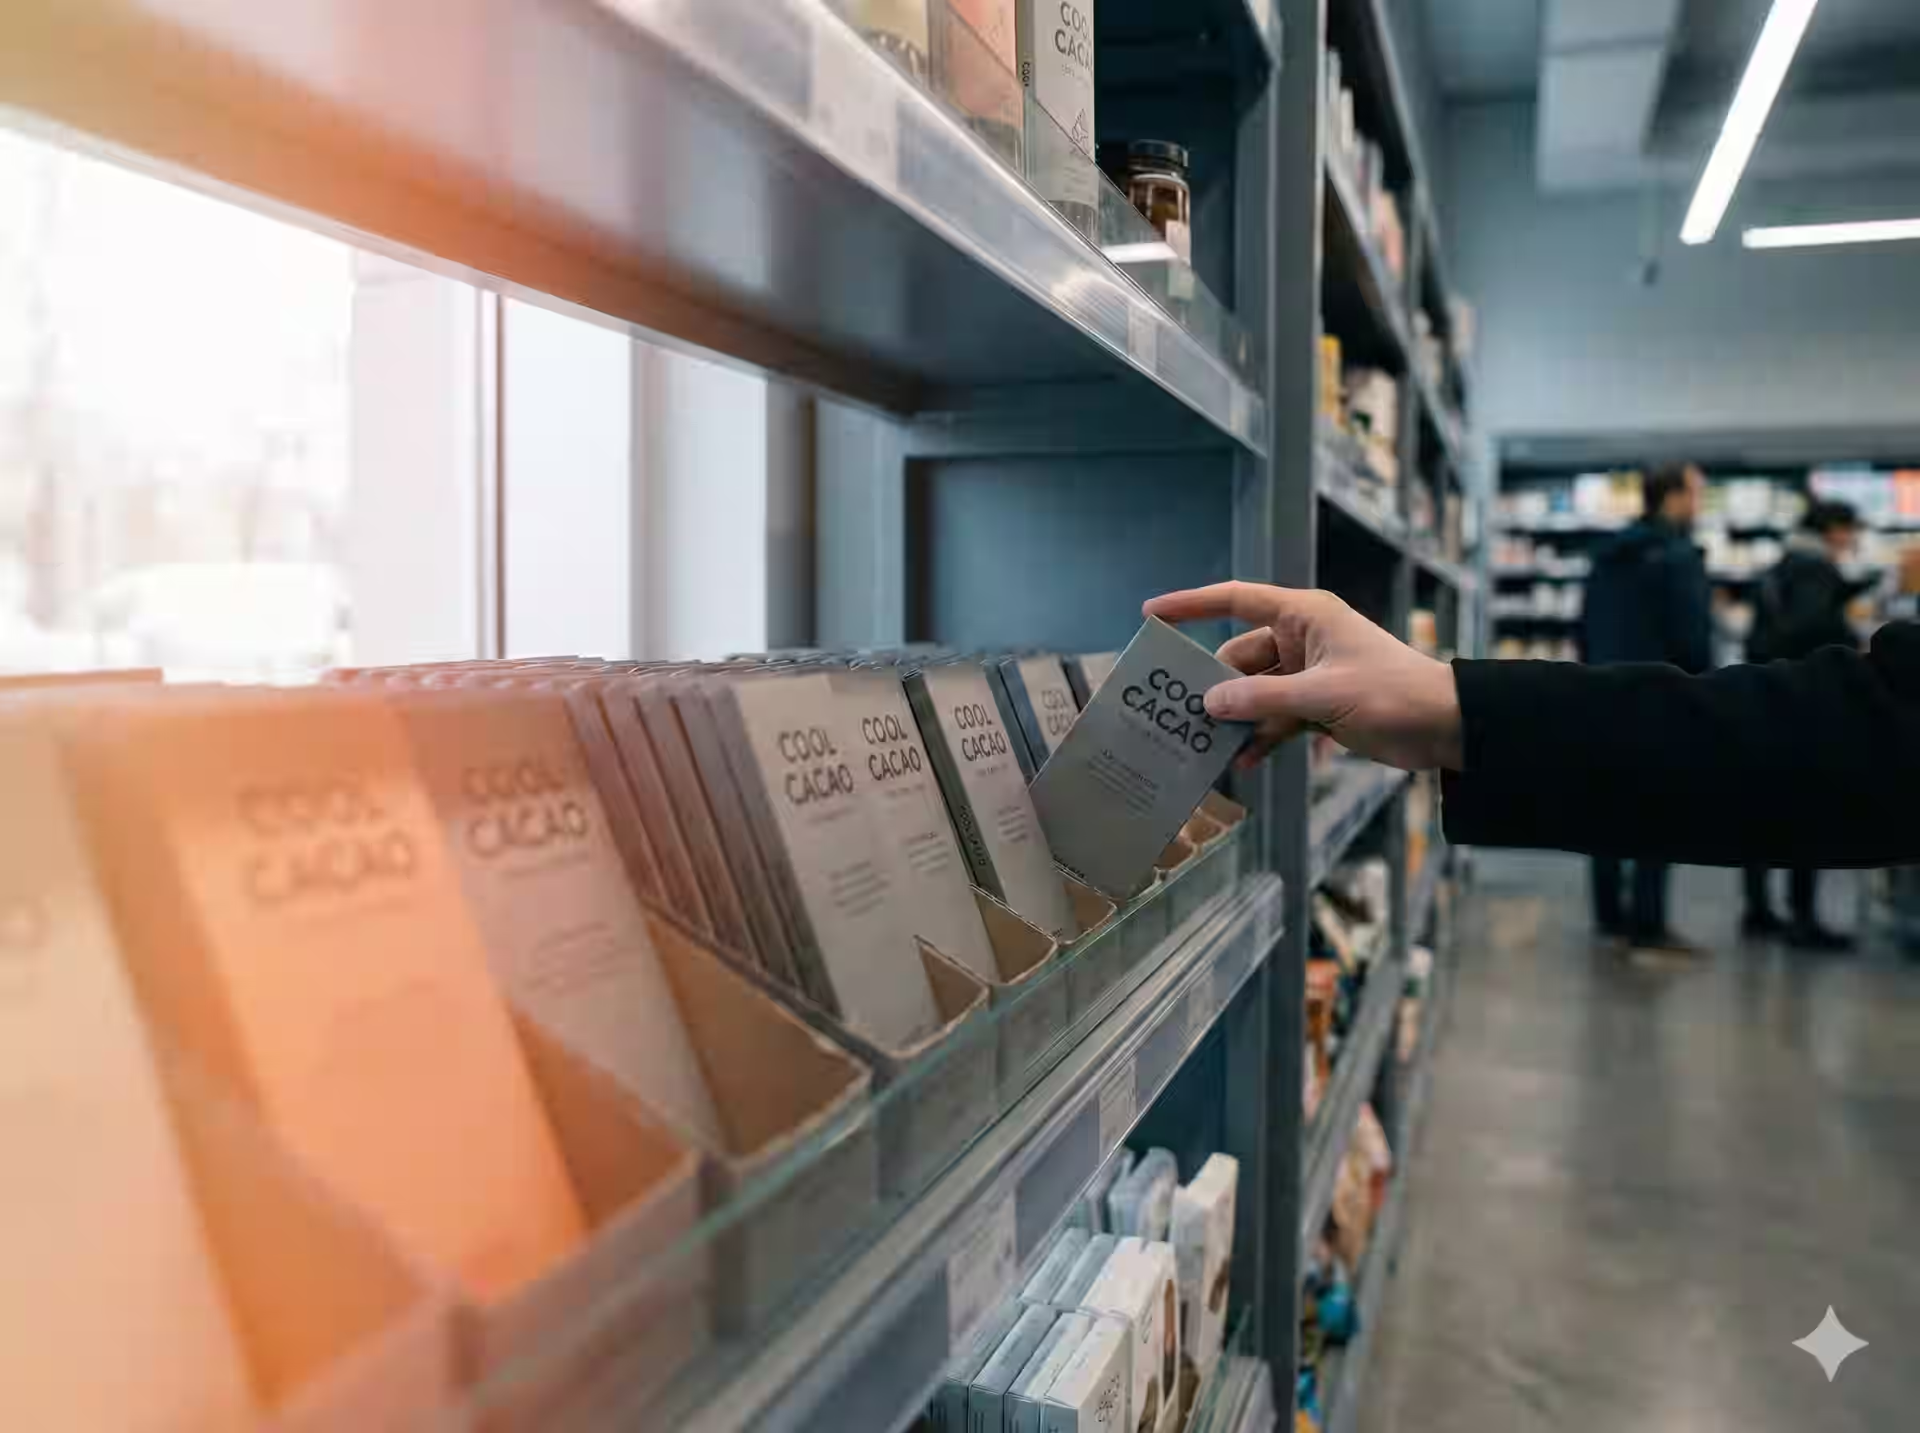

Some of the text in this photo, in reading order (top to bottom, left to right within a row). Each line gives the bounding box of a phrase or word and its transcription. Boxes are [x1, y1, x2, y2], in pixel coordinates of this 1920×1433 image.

[1060, 1, 1089, 39] COO
[1054, 29, 1091, 71] CACA
[862, 714, 908, 744] COOL
[954, 703, 992, 729] COOL
[1122, 685, 1213, 754] CACAO
[779, 728, 838, 763] COOL
[962, 731, 1007, 761] CACAO
[868, 746, 921, 781] CACAO
[785, 763, 853, 805] CACAO
